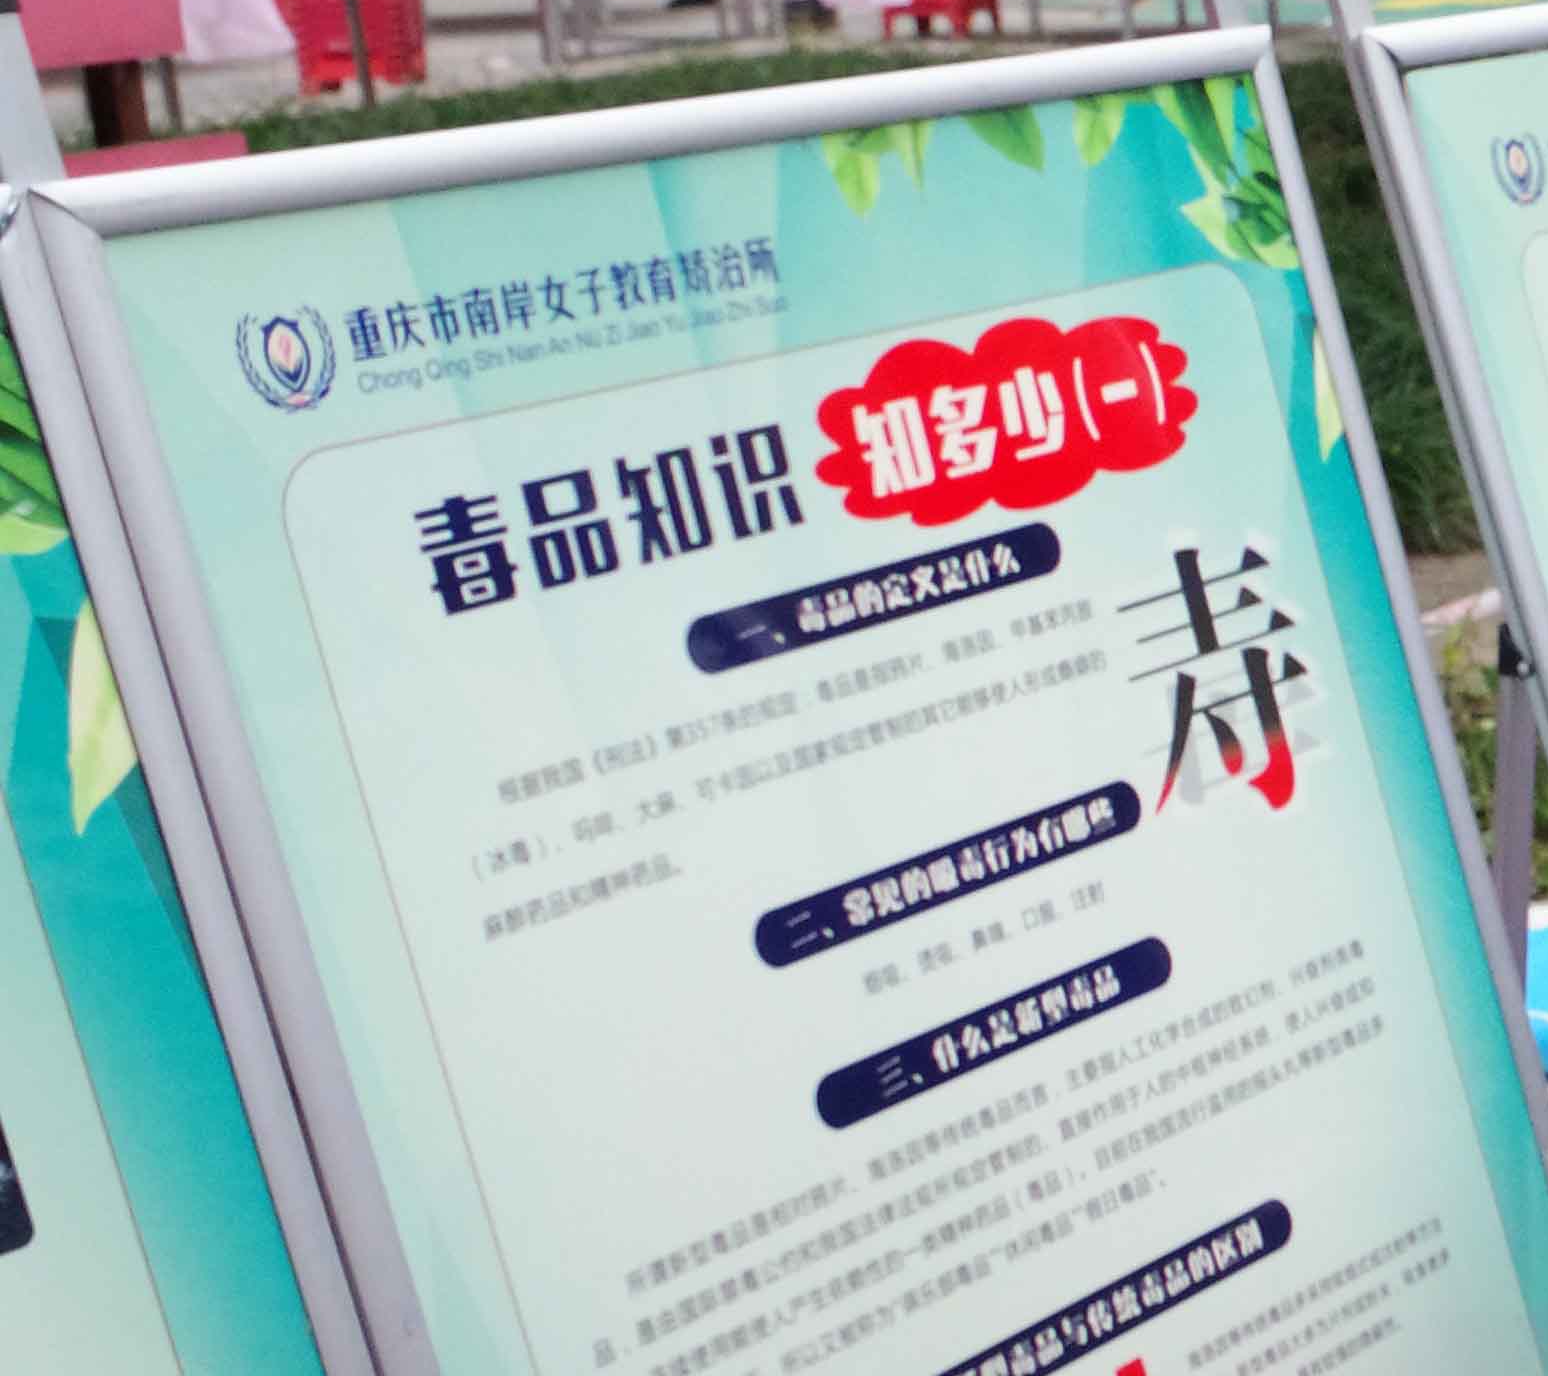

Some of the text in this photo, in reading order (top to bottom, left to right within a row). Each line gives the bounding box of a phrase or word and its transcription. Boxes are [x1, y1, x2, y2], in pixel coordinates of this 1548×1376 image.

[344, 237, 781, 362] 重庆市南岸女子教育矫治所
[357, 367, 423, 393] Chong
[426, 356, 470, 381] Qing
[414, 423, 808, 616] 毒品知识
[874, 963, 1123, 1099] 三、什么是新型毒品
